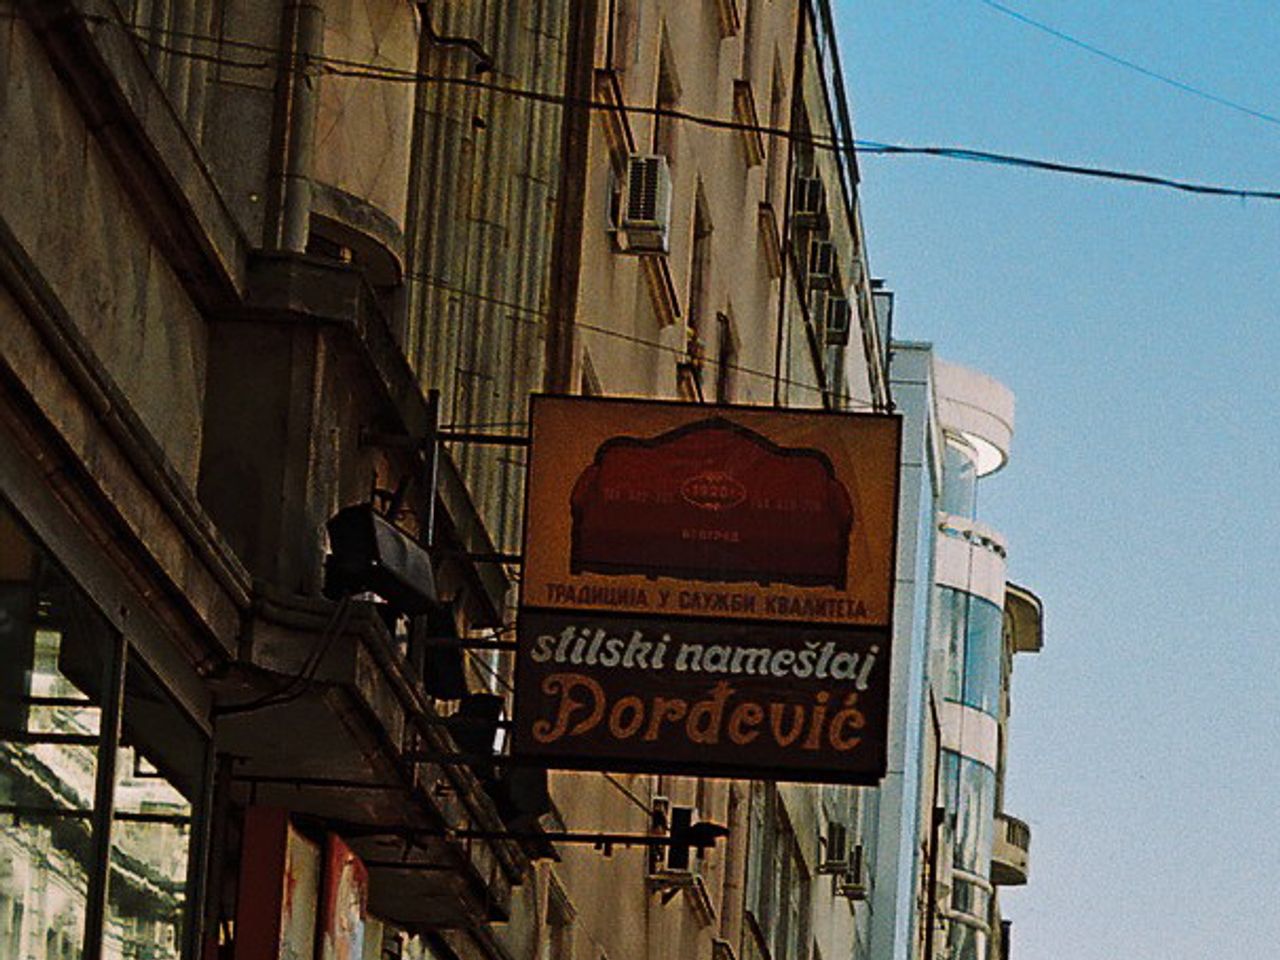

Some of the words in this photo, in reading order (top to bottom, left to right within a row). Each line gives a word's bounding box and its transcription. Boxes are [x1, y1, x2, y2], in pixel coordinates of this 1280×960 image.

[545, 582, 647, 606] ТРАДИЦИЈА
[658, 591, 671, 608] У
[678, 590, 757, 613] СЛУЖБИ
[766, 596, 868, 619] КВАЛИТЕТА
[530, 625, 670, 672] stilski
[675, 639, 879, 691] nameštaj
[532, 672, 867, 751] Đorđević
